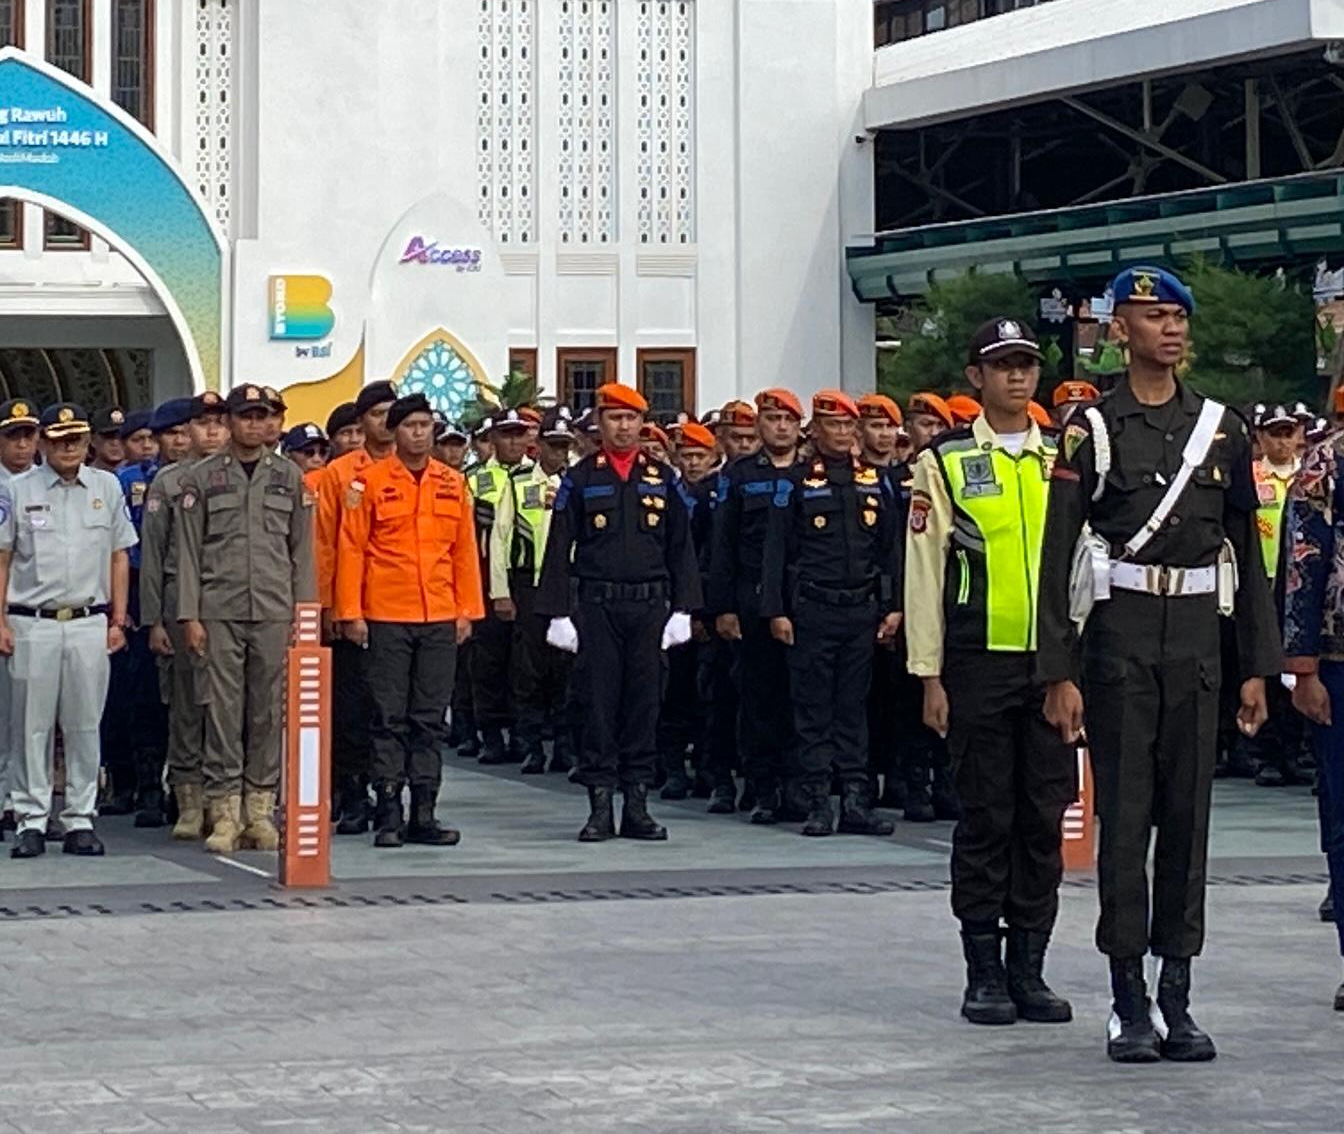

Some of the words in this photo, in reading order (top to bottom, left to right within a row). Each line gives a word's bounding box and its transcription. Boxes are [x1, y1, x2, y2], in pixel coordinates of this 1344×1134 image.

[10, 106, 67, 123] Rawuh
[13, 130, 49, 145] Fitri
[50, 130, 92, 146] 1446
[94, 131, 108, 146] H
